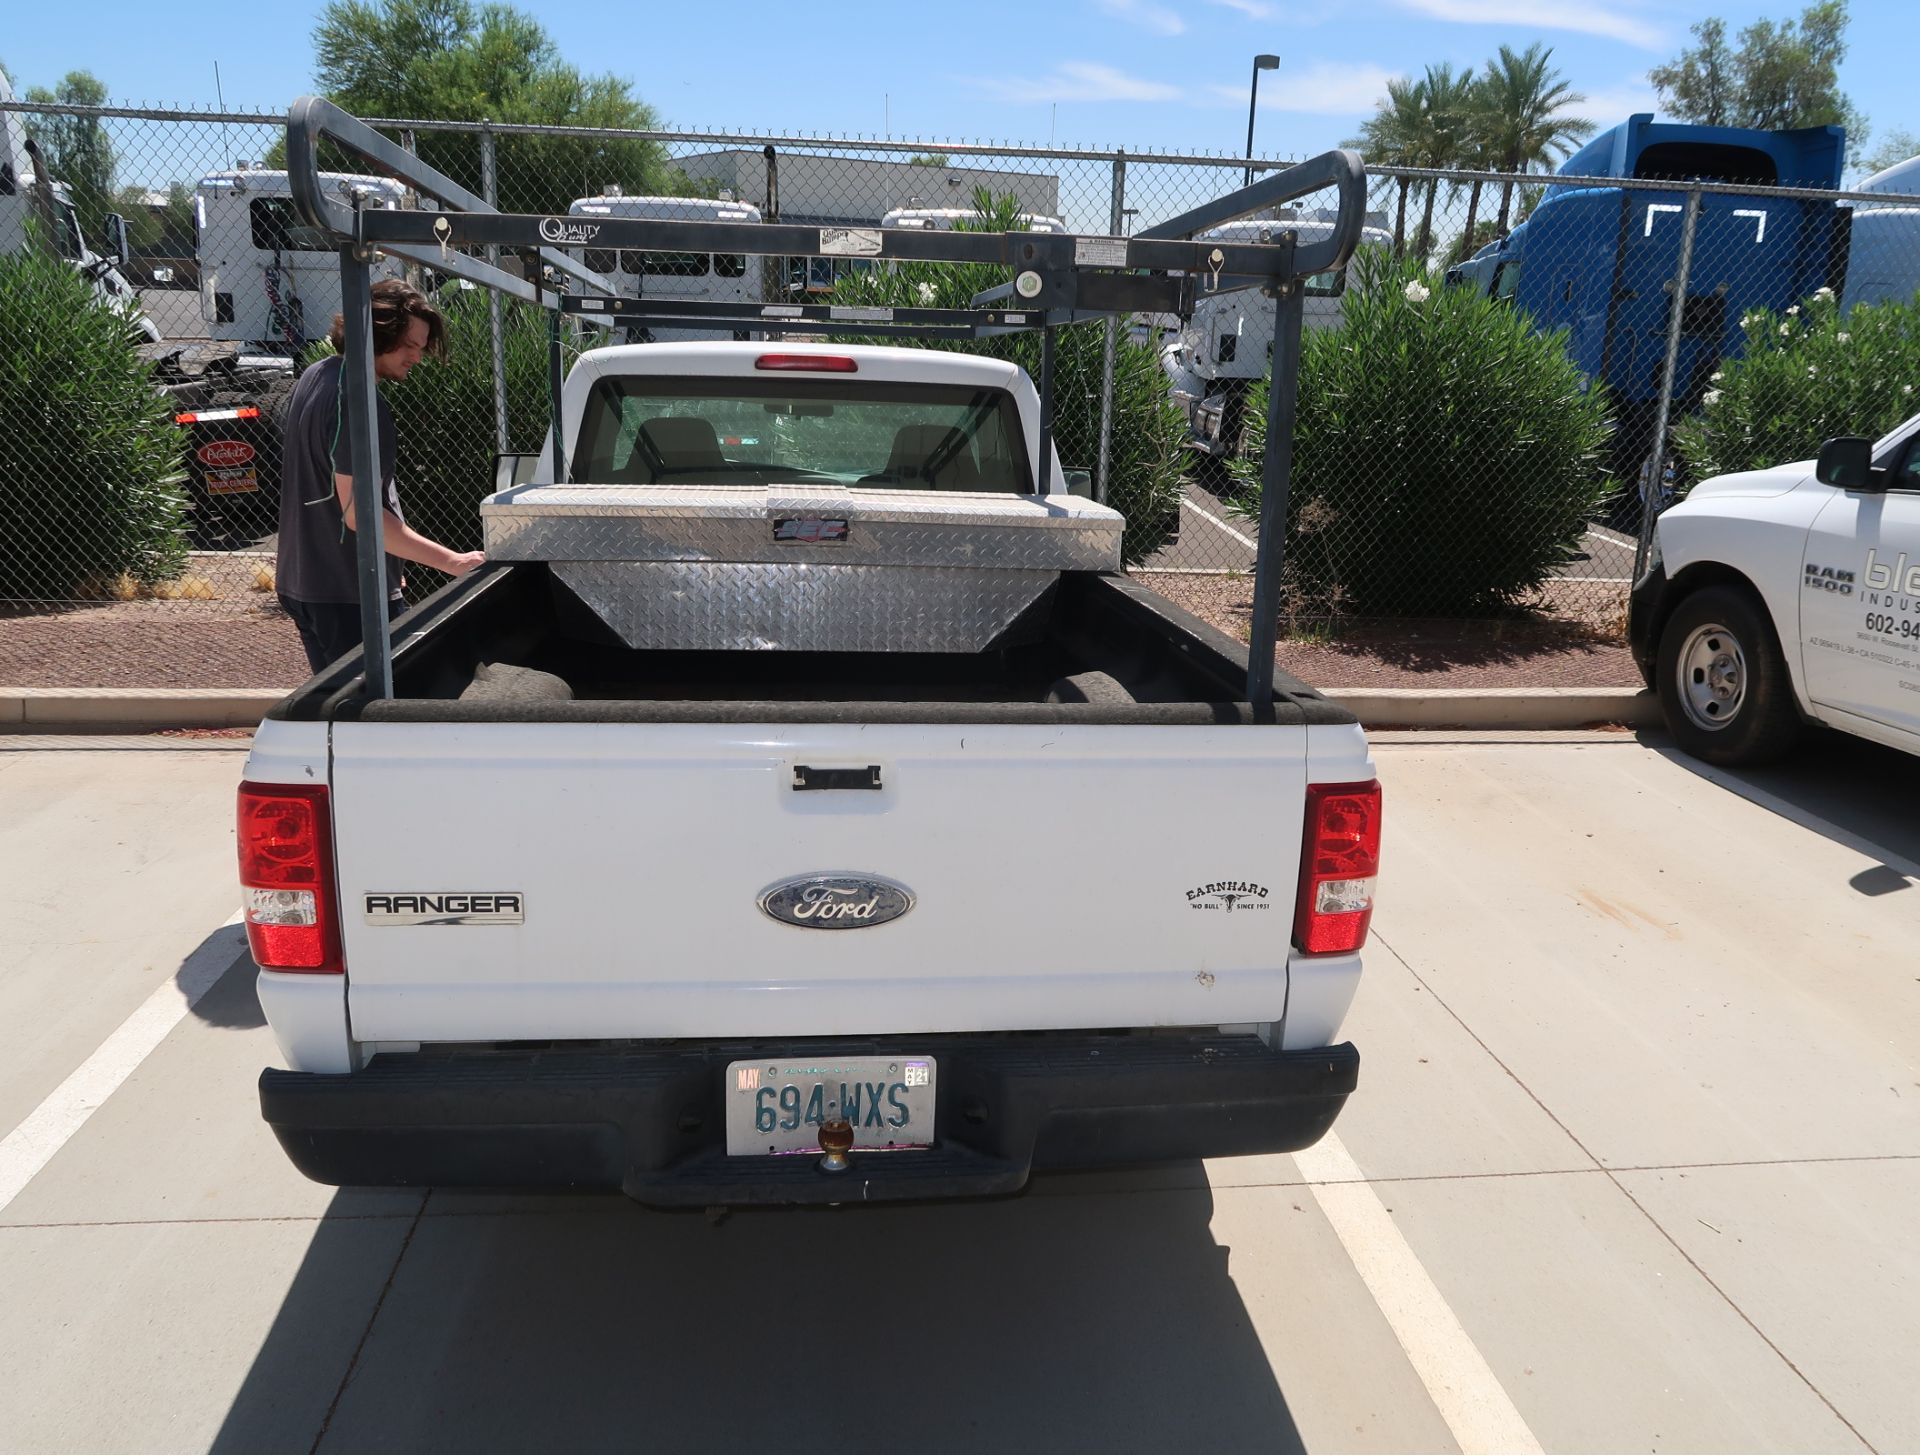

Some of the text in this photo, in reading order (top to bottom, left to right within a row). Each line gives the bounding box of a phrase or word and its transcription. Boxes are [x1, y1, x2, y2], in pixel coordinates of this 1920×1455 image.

[557, 231, 597, 243] Bumpr
[1805, 563, 1856, 583] RAM
[1804, 575, 1854, 595] 1500
[1186, 881, 1268, 901] EARNHARD
[366, 895, 520, 914] RANGER
[793, 886, 880, 919] Ford
[738, 1069, 760, 1089] MAY
[916, 1070, 929, 1083] 21
